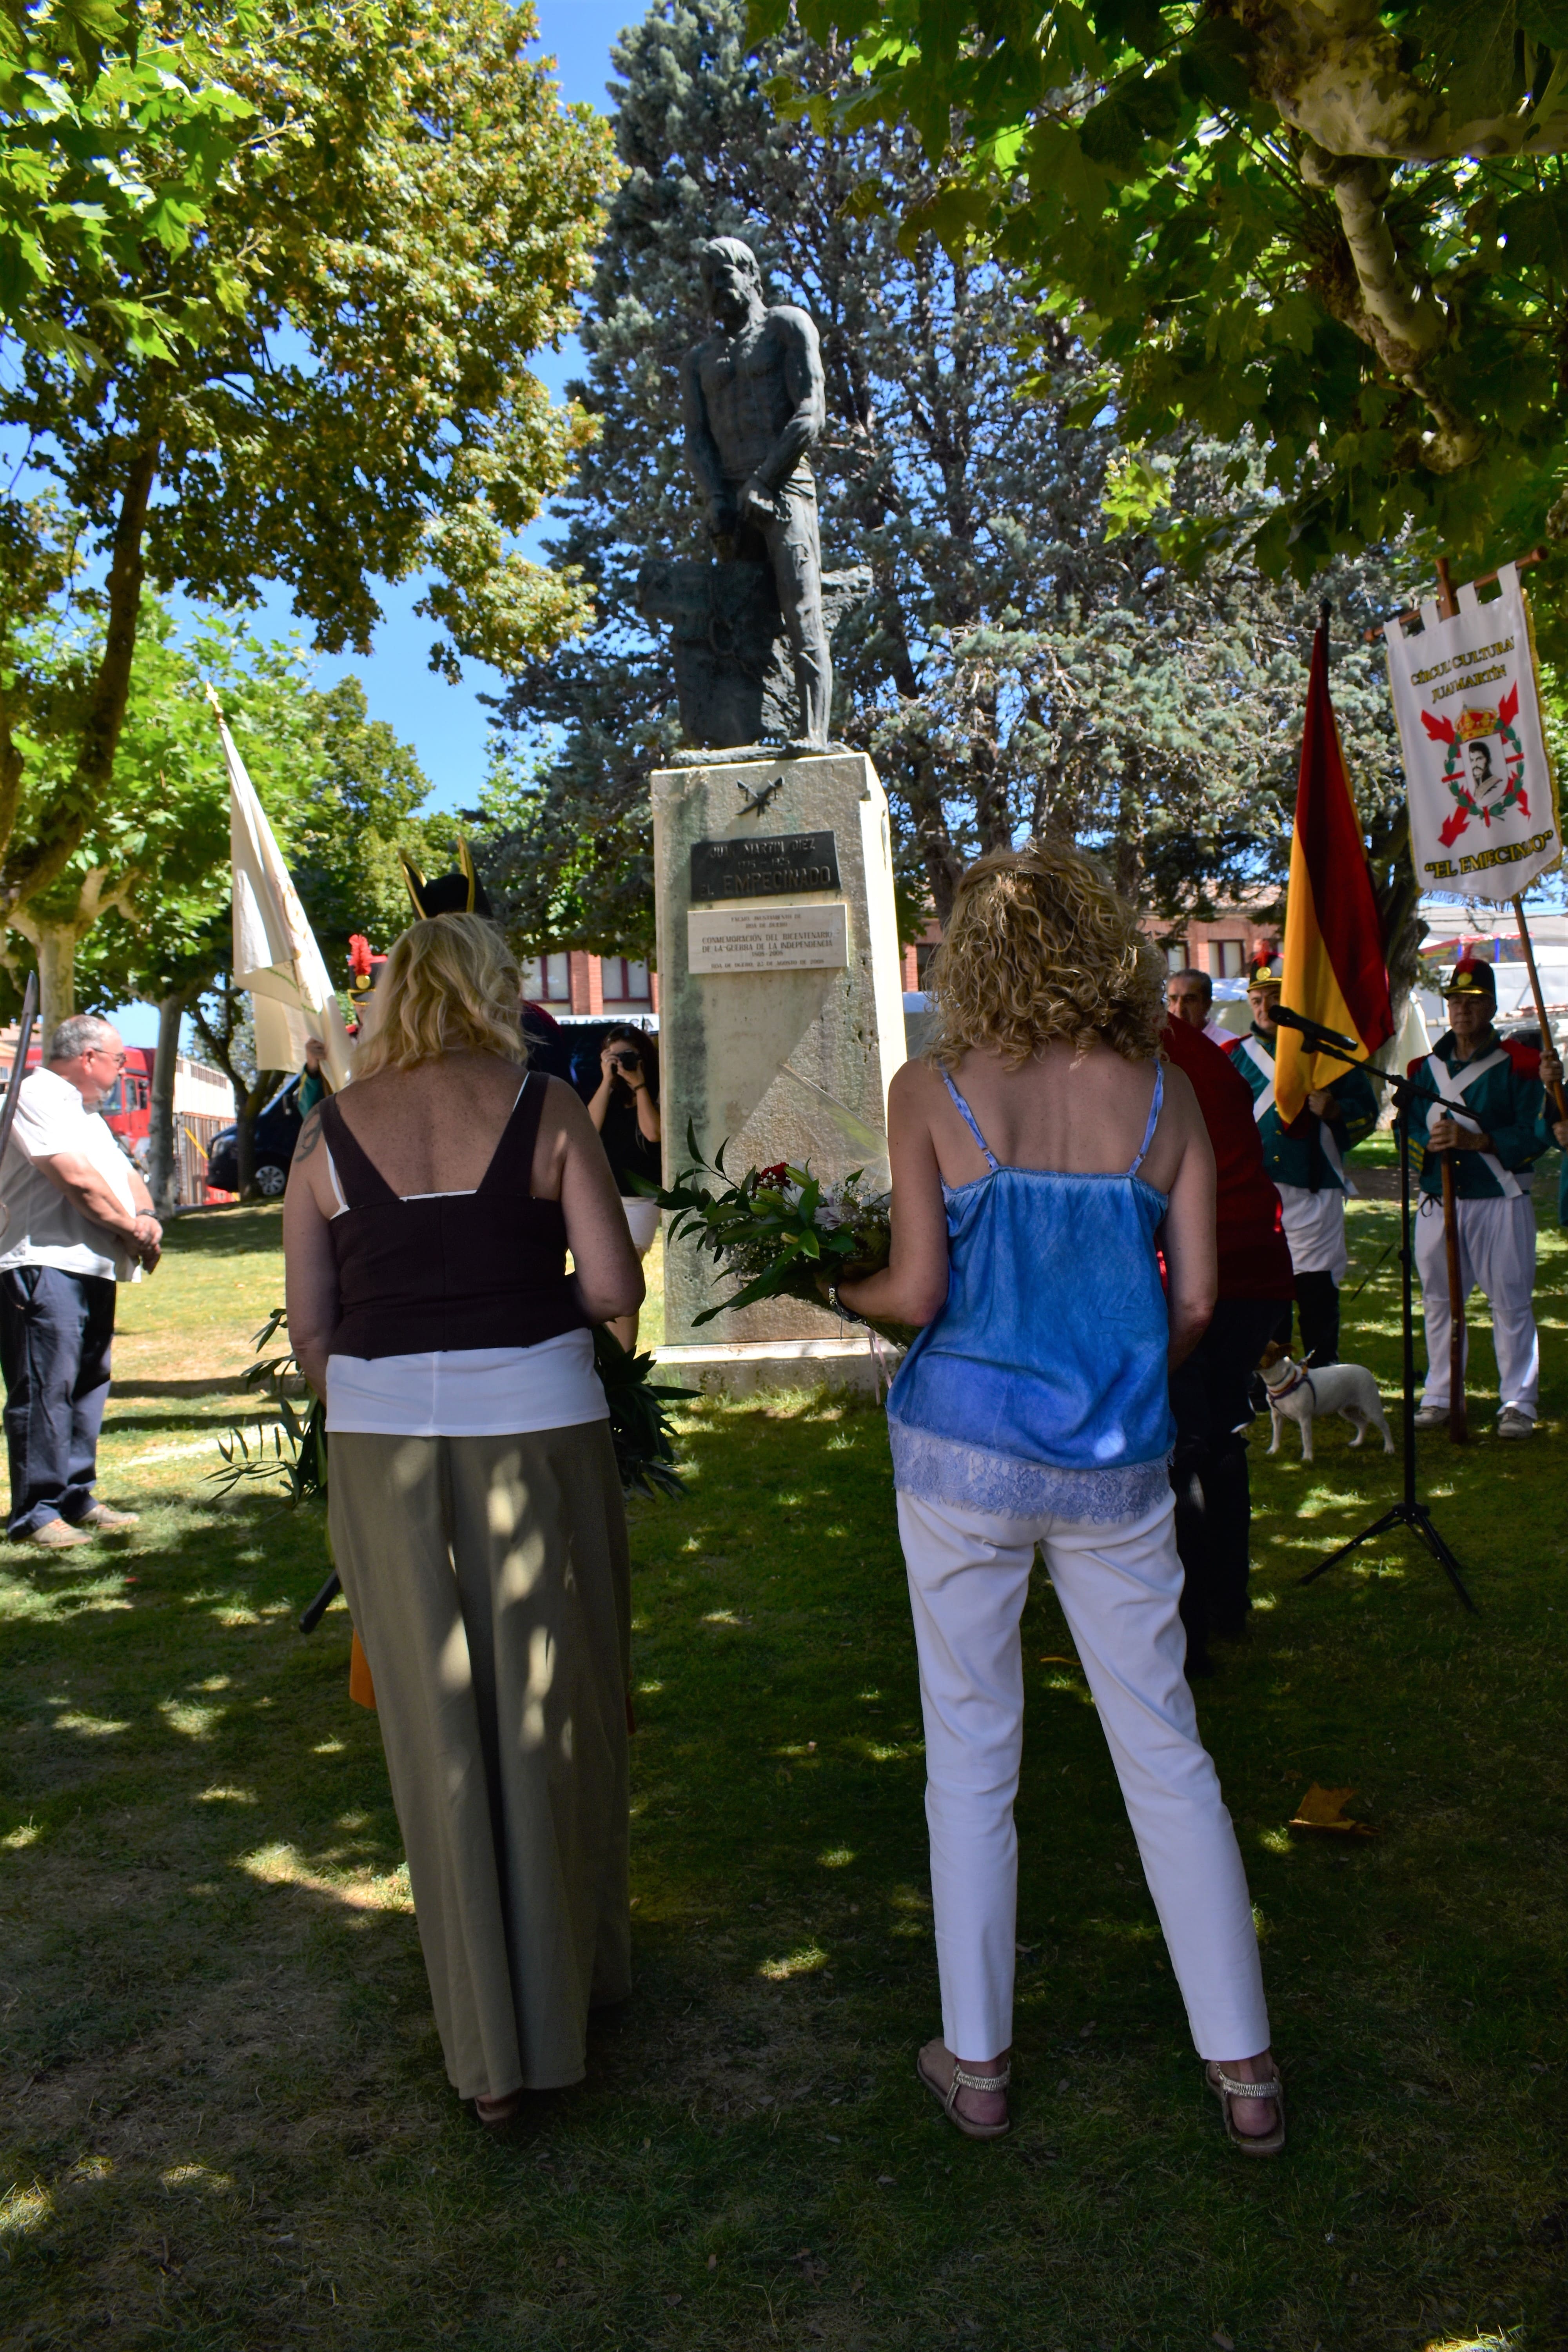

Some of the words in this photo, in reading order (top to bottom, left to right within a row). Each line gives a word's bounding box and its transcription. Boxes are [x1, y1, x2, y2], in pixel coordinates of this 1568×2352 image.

[710, 846, 735, 858] JUAN
[699, 883, 715, 897] EL
[723, 866, 830, 894] EMPECINADO
[702, 933, 762, 944] CONMEMORACIÓN
[782, 931, 833, 940] BICENTENARIO
[726, 943, 753, 951] GUERRA
[780, 939, 833, 949] INDEPENDENCIA
